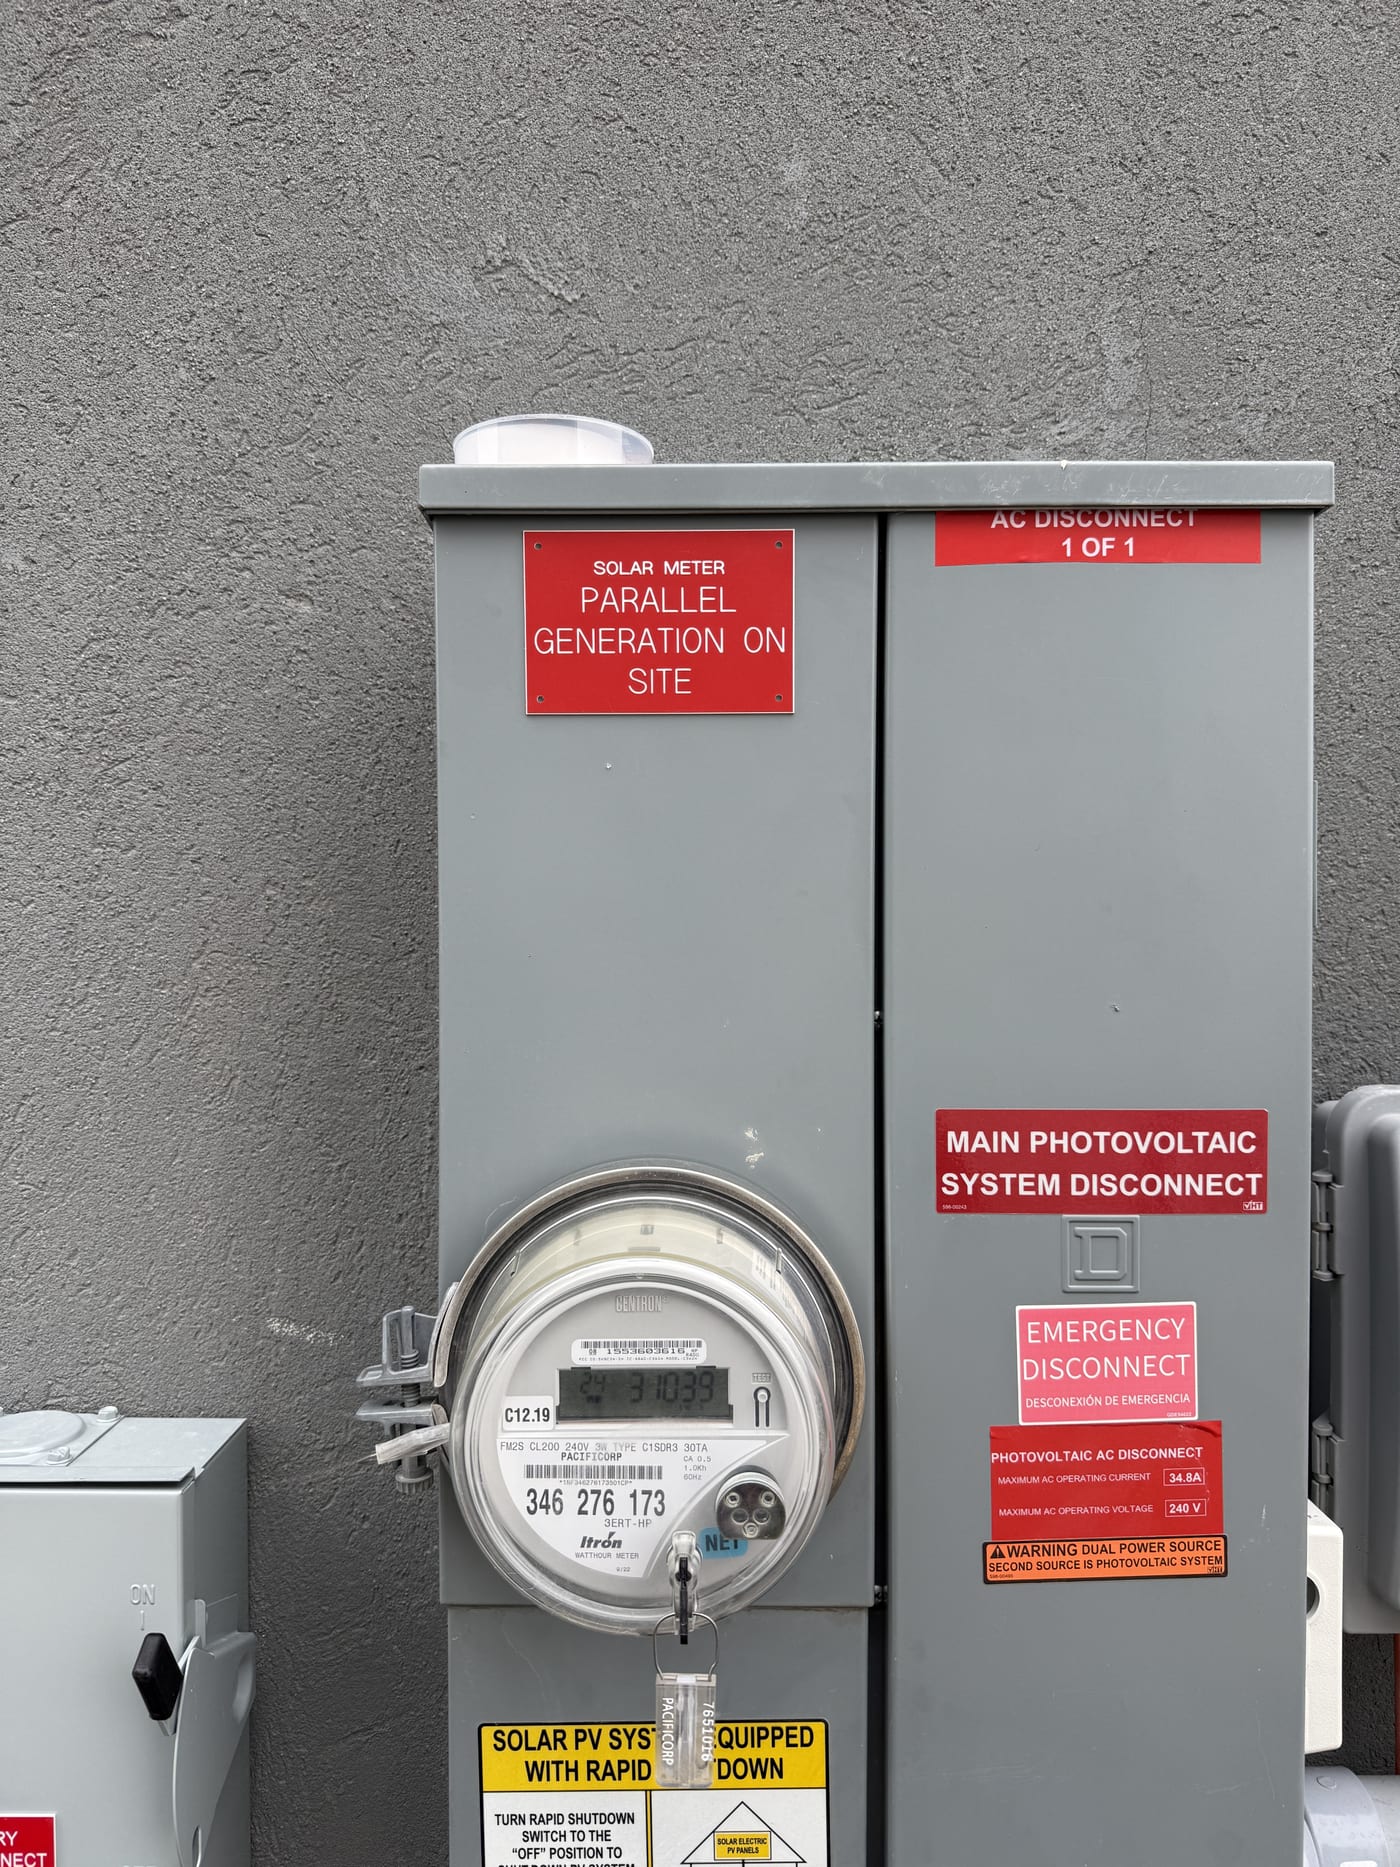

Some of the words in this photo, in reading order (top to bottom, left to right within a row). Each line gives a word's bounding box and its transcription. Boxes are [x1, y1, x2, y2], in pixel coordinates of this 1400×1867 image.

[991, 510, 1026, 529] AC
[1035, 509, 1198, 528] DISCONNECT
[1062, 538, 1072, 557] 1
[1082, 537, 1115, 557] OF
[1124, 538, 1135, 557] 1
[593, 561, 653, 575] SOLAR
[664, 561, 725, 575] METER
[581, 586, 736, 613] PARALLEL
[534, 627, 724, 654] GENERATION
[744, 626, 785, 653] ON
[628, 668, 692, 694] SITE
[947, 1131, 1019, 1153] MAIN
[1030, 1131, 1257, 1154] PHOTOVOLTAIC
[941, 1173, 1061, 1196] SYSTEM
[1070, 1173, 1263, 1196] DISCONNECT
[615, 1296, 663, 1312] CENTRON
[1027, 1318, 1186, 1343] EMERGENCY
[1023, 1354, 1191, 1380] DISCONNECT
[753, 1374, 770, 1382] TEST
[1026, 1394, 1102, 1409] DESCONEXIÓN
[1105, 1395, 1118, 1406] DE
[1122, 1393, 1190, 1405] EMERGENCIA
[505, 1408, 550, 1423] C12.19
[500, 1442, 524, 1452] FM2S
[529, 1442, 560, 1452] CL200
[565, 1442, 589, 1452] 240V
[595, 1442, 607, 1452] 3W
[613, 1442, 637, 1452] TYPE
[642, 1442, 678, 1452] C1SDR3
[684, 1442, 708, 1452] 30TA
[991, 1450, 1093, 1463] PHOTOVOLTAIC
[1096, 1449, 1115, 1461] AC
[1118, 1446, 1203, 1460] DISCONNECT
[561, 1452, 622, 1461] PACIFICORP
[683, 1473, 702, 1481] 60Hz
[998, 1475, 1040, 1485] MAXIMUM
[1042, 1474, 1055, 1483] AC
[1056, 1473, 1107, 1483] OPERATING
[1108, 1472, 1151, 1482] CURRENT
[1169, 1473, 1202, 1483] 34.8A
[526, 1489, 563, 1516] 346
[577, 1489, 615, 1516] 276
[629, 1489, 665, 1516] 173
[999, 1507, 1041, 1517] MAXIMUM
[1043, 1506, 1057, 1516] AC
[1058, 1505, 1111, 1515] OPERATING
[1112, 1504, 1154, 1514] VOLTAGE
[1169, 1503, 1190, 1514] 240
[1193, 1503, 1201, 1513] V
[604, 1518, 652, 1528] 3ERT-HP
[580, 1531, 623, 1549] Itron
[1007, 1543, 1078, 1558] WARNING
[1082, 1543, 1116, 1555] DUAL
[1119, 1541, 1165, 1554] POWER
[1169, 1540, 1222, 1552] SOURCE
[989, 1561, 1033, 1573] SECOND
[1036, 1559, 1080, 1571] SOURCE
[1083, 1558, 1093, 1569] IS
[1096, 1556, 1177, 1569] PHOTOVOLTAIC
[1180, 1555, 1223, 1567] SYSTEM
[130, 1584, 156, 1605] ON
[493, 1729, 567, 1751] SOLAR
[574, 1729, 601, 1751] PV
[609, 1729, 657, 1750] SYS
[715, 1726, 814, 1750] QUIPPED
[661, 1697, 675, 1766] PACIFICORP
[526, 1760, 579, 1782] WITH
[586, 1759, 652, 1781] RAPID
[715, 1758, 784, 1780] DOWN
[495, 1813, 527, 1826] TURN
[529, 1813, 565, 1825] RAPID
[568, 1812, 635, 1825] SHUTDOWN
[0, 1831, 18, 1846] RY
[522, 1831, 566, 1843] SWITCH
[569, 1831, 586, 1842] TO
[588, 1830, 612, 1842] THE
[717, 1837, 738, 1846] SOLAR
[739, 1837, 767, 1845] ELECTRIC
[549, 1847, 603, 1859] POSITION
[606, 1847, 622, 1859] TO
[726, 1846, 736, 1855] PV
[736, 1846, 760, 1854] PANELS
[0, 1852, 48, 1867] NECT
